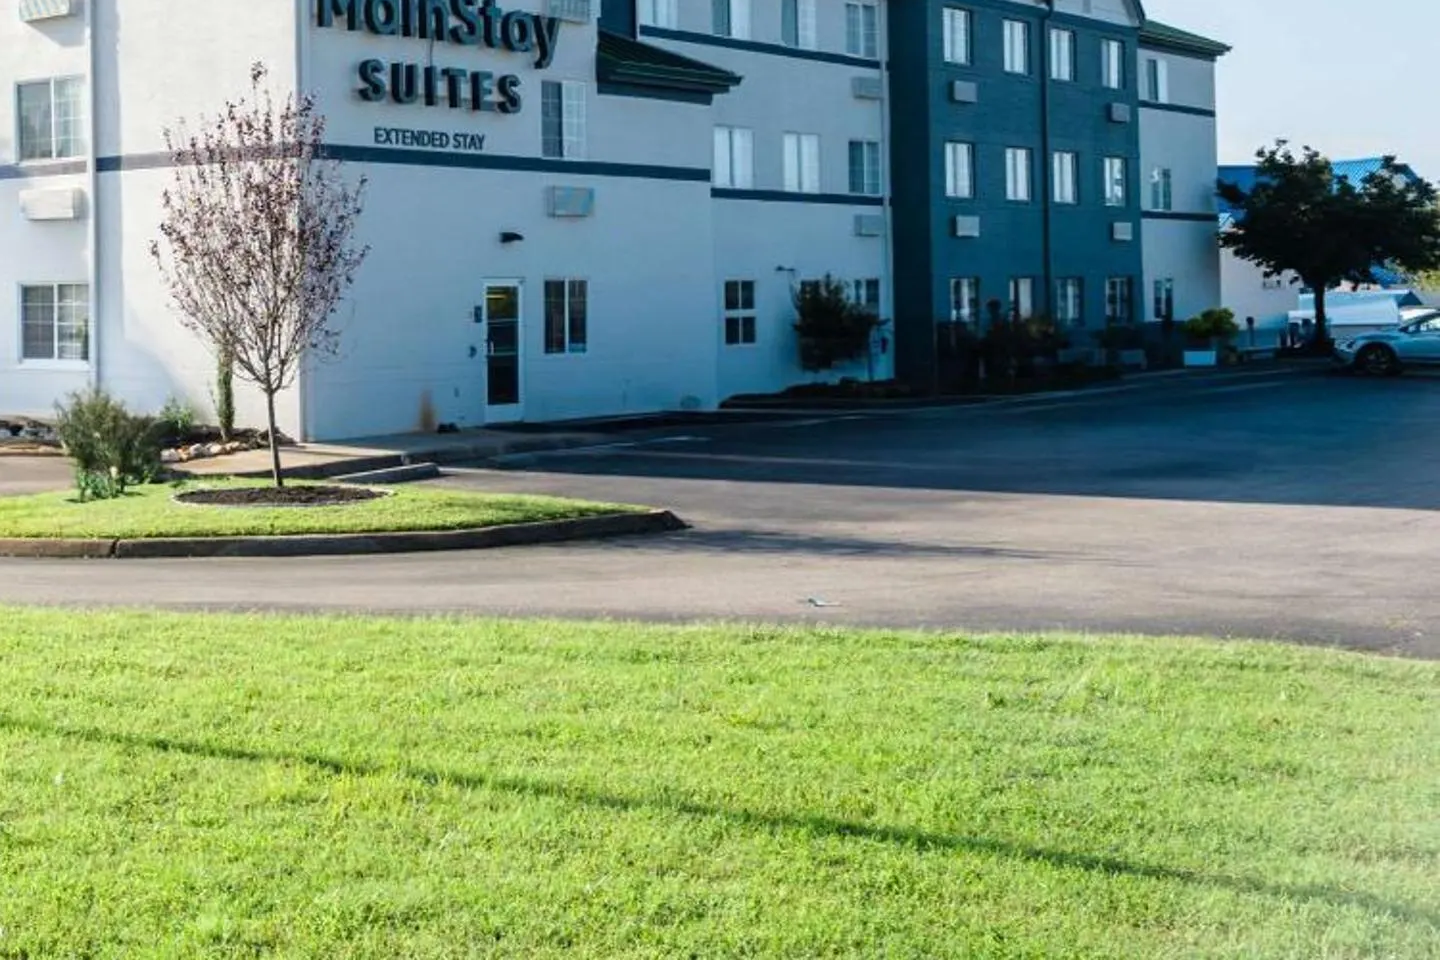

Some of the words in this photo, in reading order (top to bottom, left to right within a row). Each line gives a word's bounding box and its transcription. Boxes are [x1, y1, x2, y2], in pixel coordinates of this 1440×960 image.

[358, 58, 523, 114] SUITES
[374, 126, 450, 149] EXTENDED
[452, 132, 486, 151] STAY
